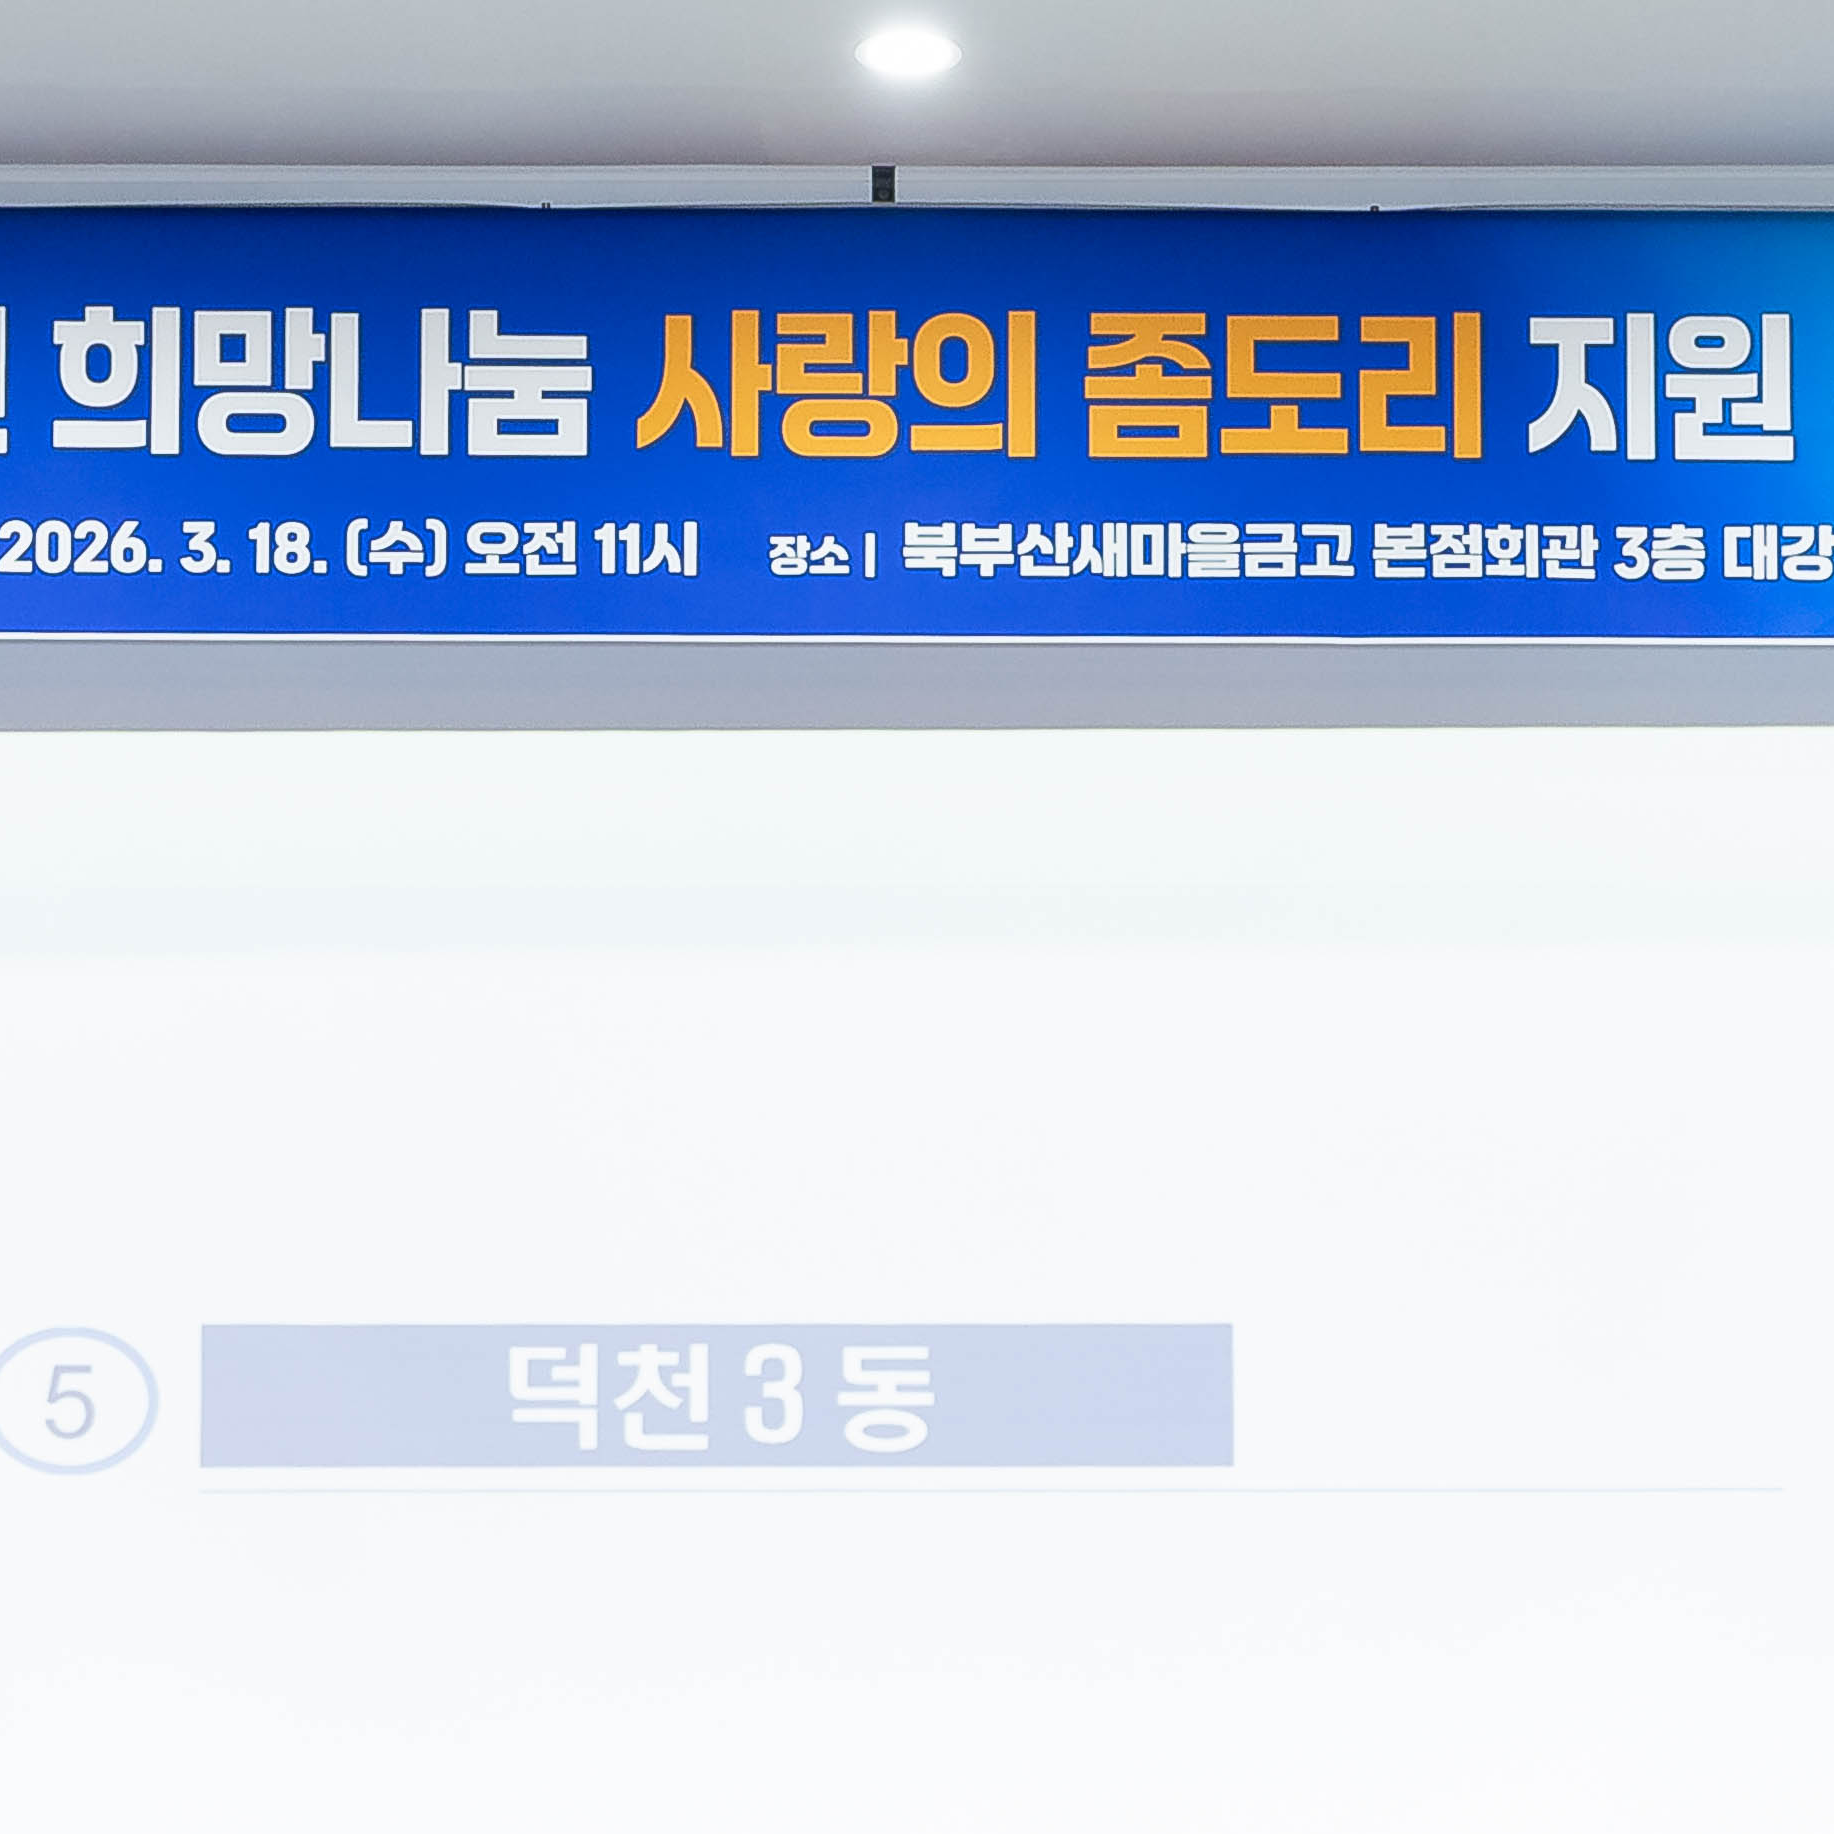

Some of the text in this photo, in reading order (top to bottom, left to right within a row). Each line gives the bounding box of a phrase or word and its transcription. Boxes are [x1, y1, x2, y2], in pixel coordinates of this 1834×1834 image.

[53, 307, 592, 455] 희망나눔
[638, 311, 1035, 456] 사랑의
[1086, 313, 1481, 458] 좀도리
[1529, 314, 1793, 460] 지원
[347, 519, 446, 576] (수)
[465, 521, 576, 575] 오전
[595, 522, 697, 576] 11시
[770, 536, 849, 575] 장소
[903, 523, 1354, 577] 북부산새마을금고
[1373, 524, 1598, 579] 본점회관
[1614, 524, 1705, 579] 3층
[510, 1344, 708, 1449] 덕천
